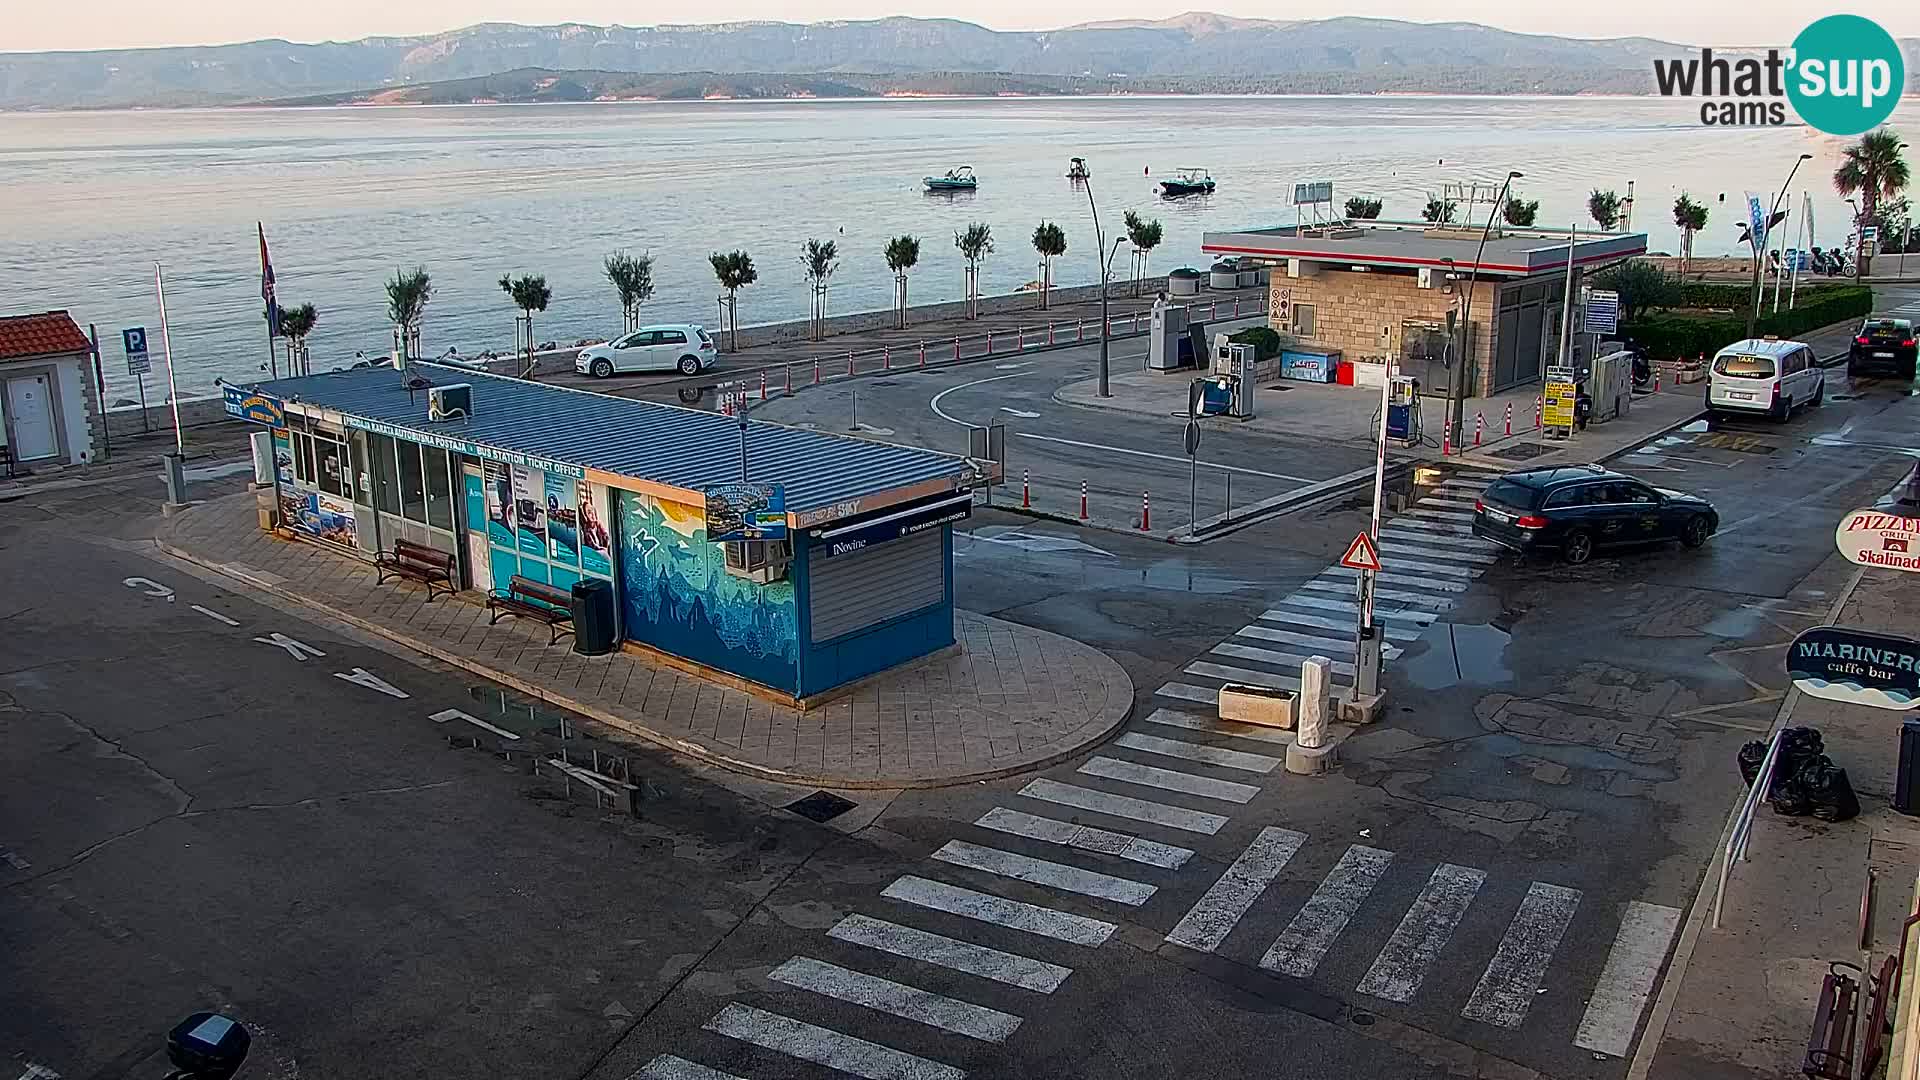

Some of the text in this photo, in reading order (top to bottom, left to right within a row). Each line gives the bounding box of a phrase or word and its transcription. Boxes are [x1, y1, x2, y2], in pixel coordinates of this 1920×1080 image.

[128, 332, 141, 350] P
[394, 427, 435, 445] AUTOBUSNA
[435, 437, 467, 452] POSTAJA
[477, 445, 492, 458] BUS
[493, 450, 525, 465] STATION
[527, 457, 553, 472] TICKET
[554, 463, 581, 478] OFFICE
[1880, 530, 1916, 541] GRILL
[1827, 662, 1896, 680] caffe bar
